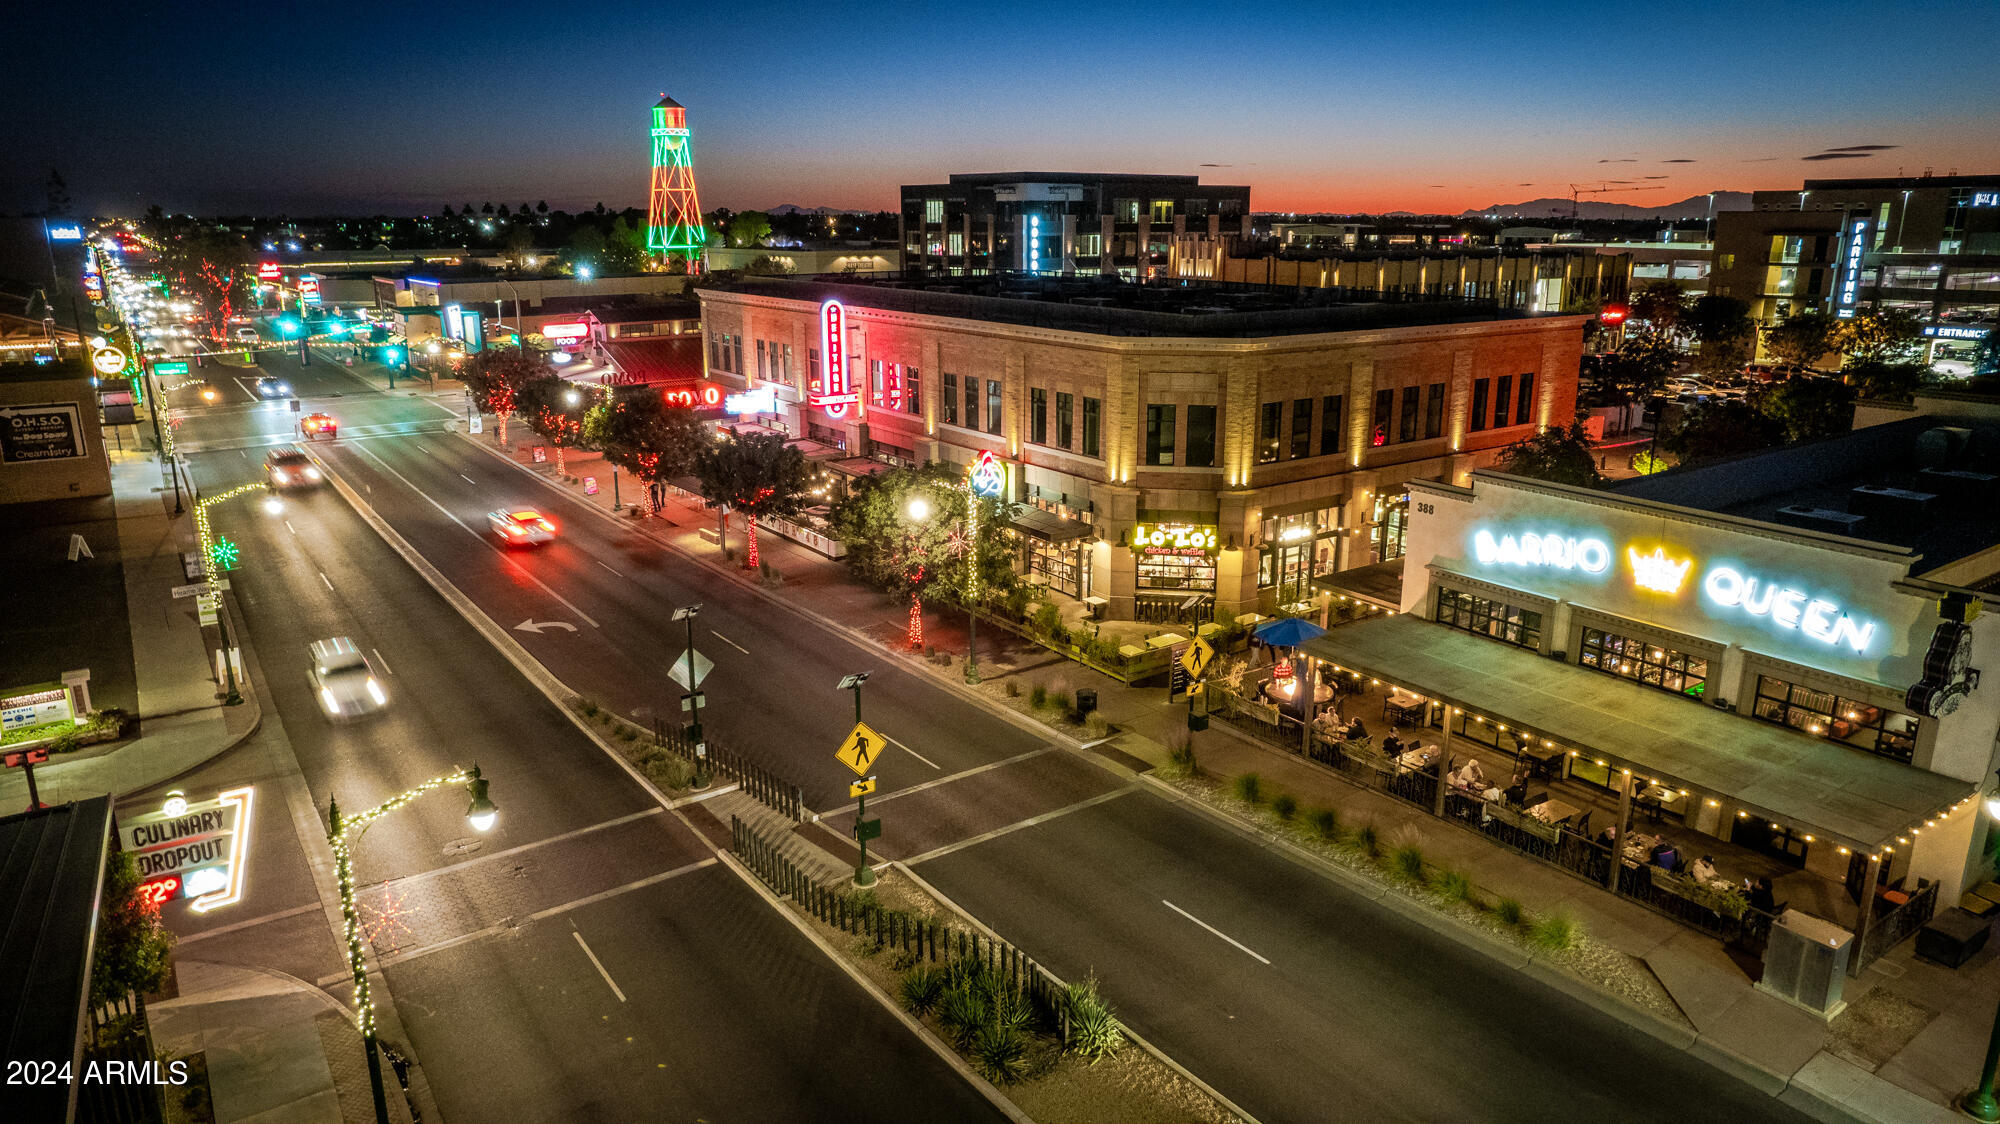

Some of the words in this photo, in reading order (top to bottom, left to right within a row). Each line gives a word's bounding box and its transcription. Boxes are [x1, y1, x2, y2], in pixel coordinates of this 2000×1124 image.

[1843, 222, 1865, 304] PARKING
[1937, 328, 1988, 339] ENTRANCE
[557, 337, 577, 345] FOOD
[11, 416, 65, 428] O.H.S.O.
[16, 448, 72, 459] Creamistry
[1417, 502, 1435, 515] 388
[1474, 530, 1610, 576] BARRIO
[1705, 567, 1876, 655] QUEEN
[2, 706, 33, 716] PSYCHIC
[132, 809, 224, 848] CULINARY
[138, 838, 223, 876] DROPOUT
